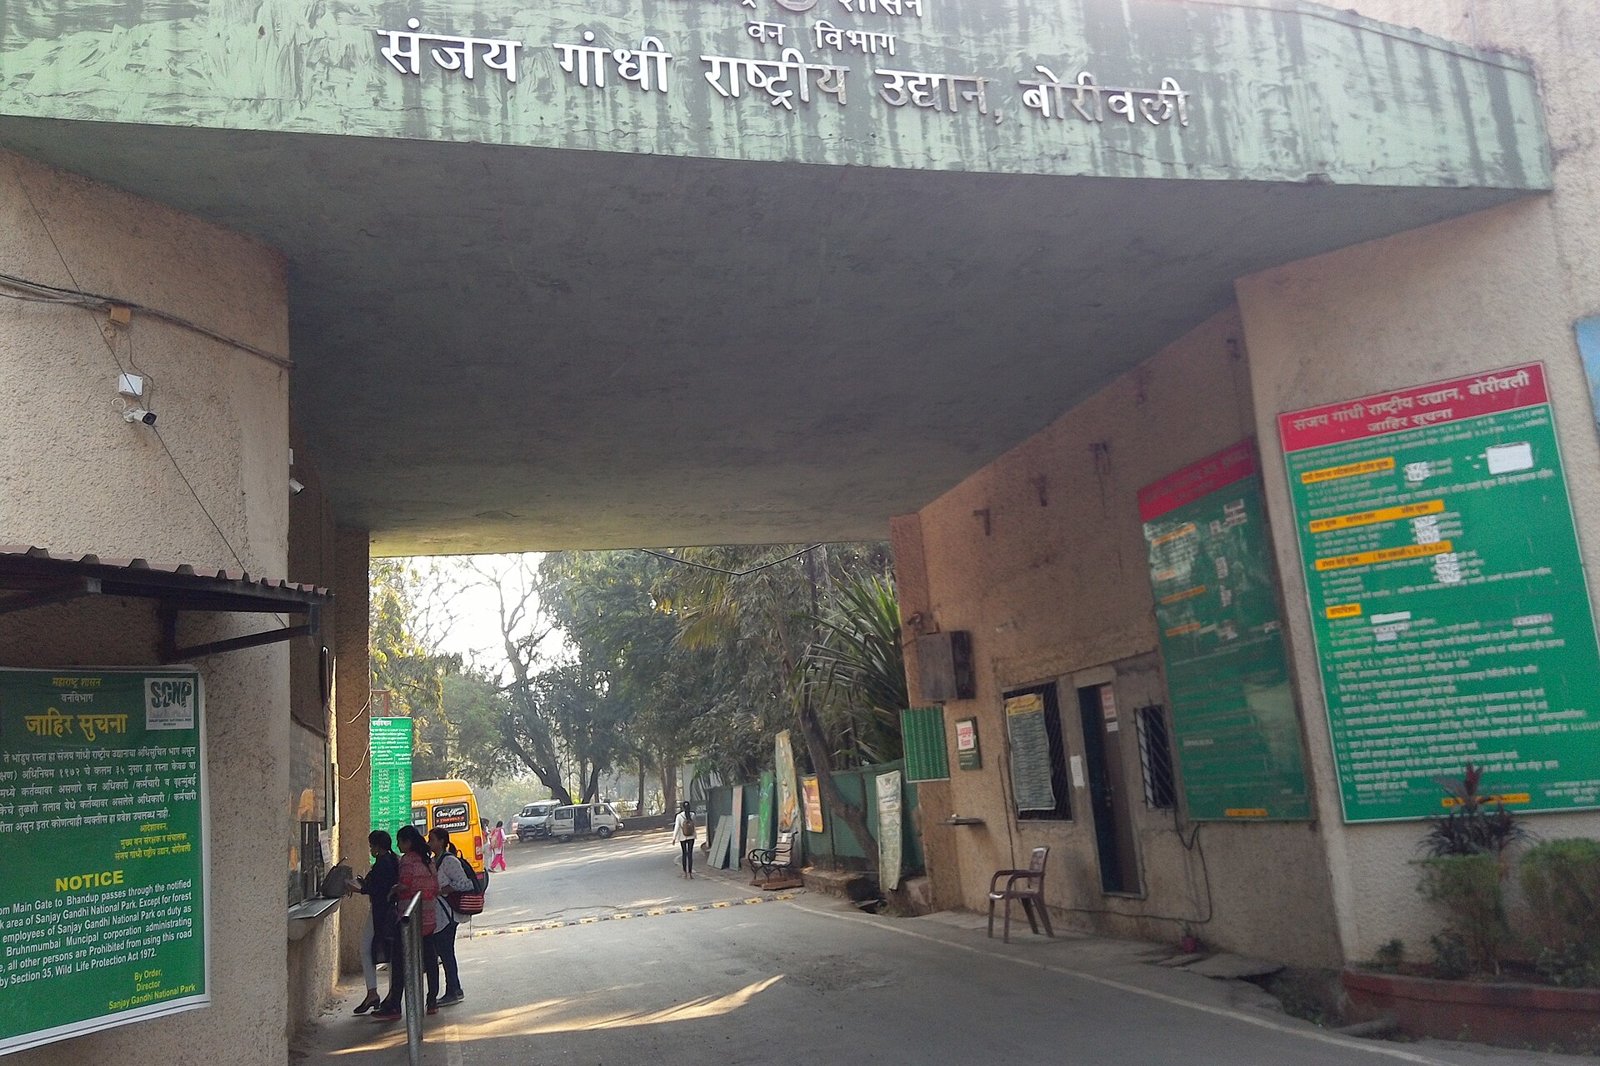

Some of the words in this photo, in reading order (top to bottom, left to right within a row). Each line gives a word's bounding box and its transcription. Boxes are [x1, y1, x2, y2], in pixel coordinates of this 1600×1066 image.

[747, 20, 786, 46] वन
[814, 19, 896, 56] विभाग
[377, 17, 522, 83] संजय
[553, 30, 673, 94] गांधी
[699, 47, 850, 110] राष्ट्रीय
[1018, 64, 1191, 127] बोरीवली
[1293, 412, 1329, 432] संजय
[1332, 402, 1365, 423] गांधी
[1368, 394, 1414, 417] राष्ट्रीय
[1468, 371, 1530, 396] बोरीवली
[1367, 414, 1409, 434] जाहिर
[150, 681, 192, 708] SGNP
[24, 707, 74, 737] जाहिर
[77, 713, 128, 741] सुचना
[11, 751, 31, 766] भांडुप
[32, 753, 47, 761] रस्ता
[48, 752, 55, 762] हा
[57, 749, 74, 760] संजय
[76, 748, 91, 760] गांधी
[92, 747, 109, 761] राष्ट्रीय
[168, 747, 180, 755] भाग
[22, 767, 54, 779] अधिनियम
[60, 768, 80, 778] १९७२
[84, 764, 91, 776] चे
[145, 764, 152, 773] हा
[154, 763, 168, 772] रस्ता
[21, 783, 53, 796] कर्तव्यावर
[59, 781, 82, 794] असणारे
[102, 778, 128, 791] अधिकारी
[42, 802, 61, 812] तलाव
[80, 796, 108, 808] कर्तव्यावर
[112, 794, 134, 807] असलेले
[138, 791, 165, 804] अधिकारी
[174, 789, 196, 801] कर्मचारी
[36, 819, 49, 831] इतर
[55, 870, 124, 892] NOTICE
[6, 919, 24, 929] area
[25, 915, 34, 925] of
[35, 910, 62, 925] Sanjay
[62, 906, 89, 920] Gandhi
[90, 902, 120, 916] National
[121, 899, 137, 911] Park.
[139, 896, 161, 909] Except
[161, 893, 171, 904] for
[172, 891, 192, 902] forest
[13, 903, 32, 914] Main
[34, 900, 53, 911] Gate
[55, 898, 63, 907] to
[66, 893, 100, 907] Bhandup
[101, 890, 127, 903] passes
[128, 886, 153, 900] through
[155, 883, 165, 893] the
[166, 879, 192, 892] notified
[2, 927, 45, 946] employees
[47, 925, 56, 936] of
[57, 920, 83, 934] Sanjay
[84, 916, 110, 930] Gandhi
[112, 911, 140, 925] National
[140, 908, 156, 919] Park
[157, 909, 165, 917] on
[167, 905, 182, 917] duty
[183, 905, 192, 914] as
[6, 937, 61, 957] Bruhnmumbai
[66, 932, 99, 947] Muncipal
[103, 926, 142, 941] corporation
[145, 917, 192, 934] administrating
[7, 958, 18, 970] all
[20, 955, 41, 967] other
[42, 952, 74, 966] persons
[75, 949, 87, 958] are
[89, 941, 125, 956] Prohibited
[126, 938, 142, 949] from
[143, 937, 161, 949] using
[162, 932, 175, 943] this
[176, 929, 192, 940] road
[10, 971, 41, 985] Section
[55, 963, 72, 975] Wild
[75, 960, 90, 972] Life
[91, 955, 127, 969] Protection
[128, 951, 139, 961] Act
[140, 948, 157, 959] 1972.
[134, 971, 144, 981] By
[109, 998, 130, 1010] Sanjay
[131, 990, 153, 1004] Gandhi
[154, 986, 179, 999] National
[179, 984, 196, 994] Park
[136, 981, 161, 992] Director
